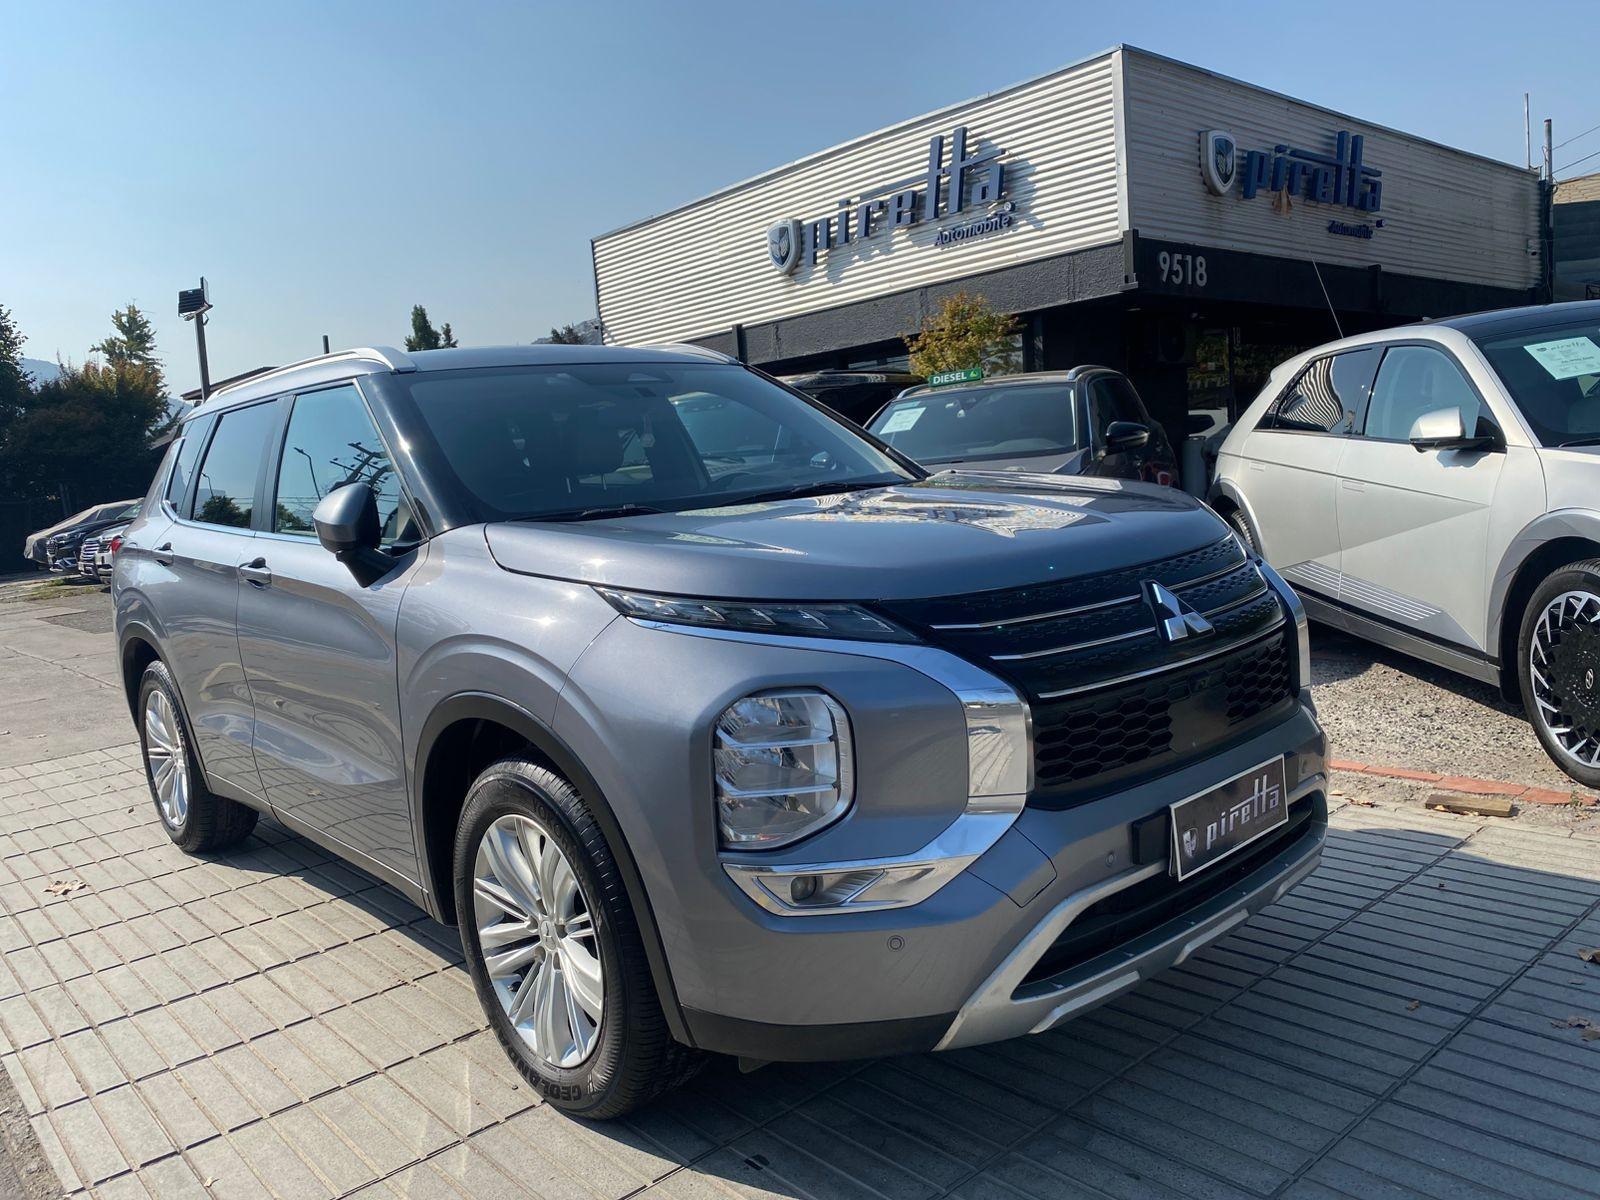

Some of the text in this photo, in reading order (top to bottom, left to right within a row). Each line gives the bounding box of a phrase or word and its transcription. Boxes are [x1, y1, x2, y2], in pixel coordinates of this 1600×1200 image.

[804, 126, 1006, 267] piretta
[1242, 130, 1383, 213] piretta
[935, 211, 1012, 247] Automobile
[1158, 250, 1208, 288] 9518
[932, 371, 968, 385] DIESEL
[1205, 773, 1280, 851] piretta
